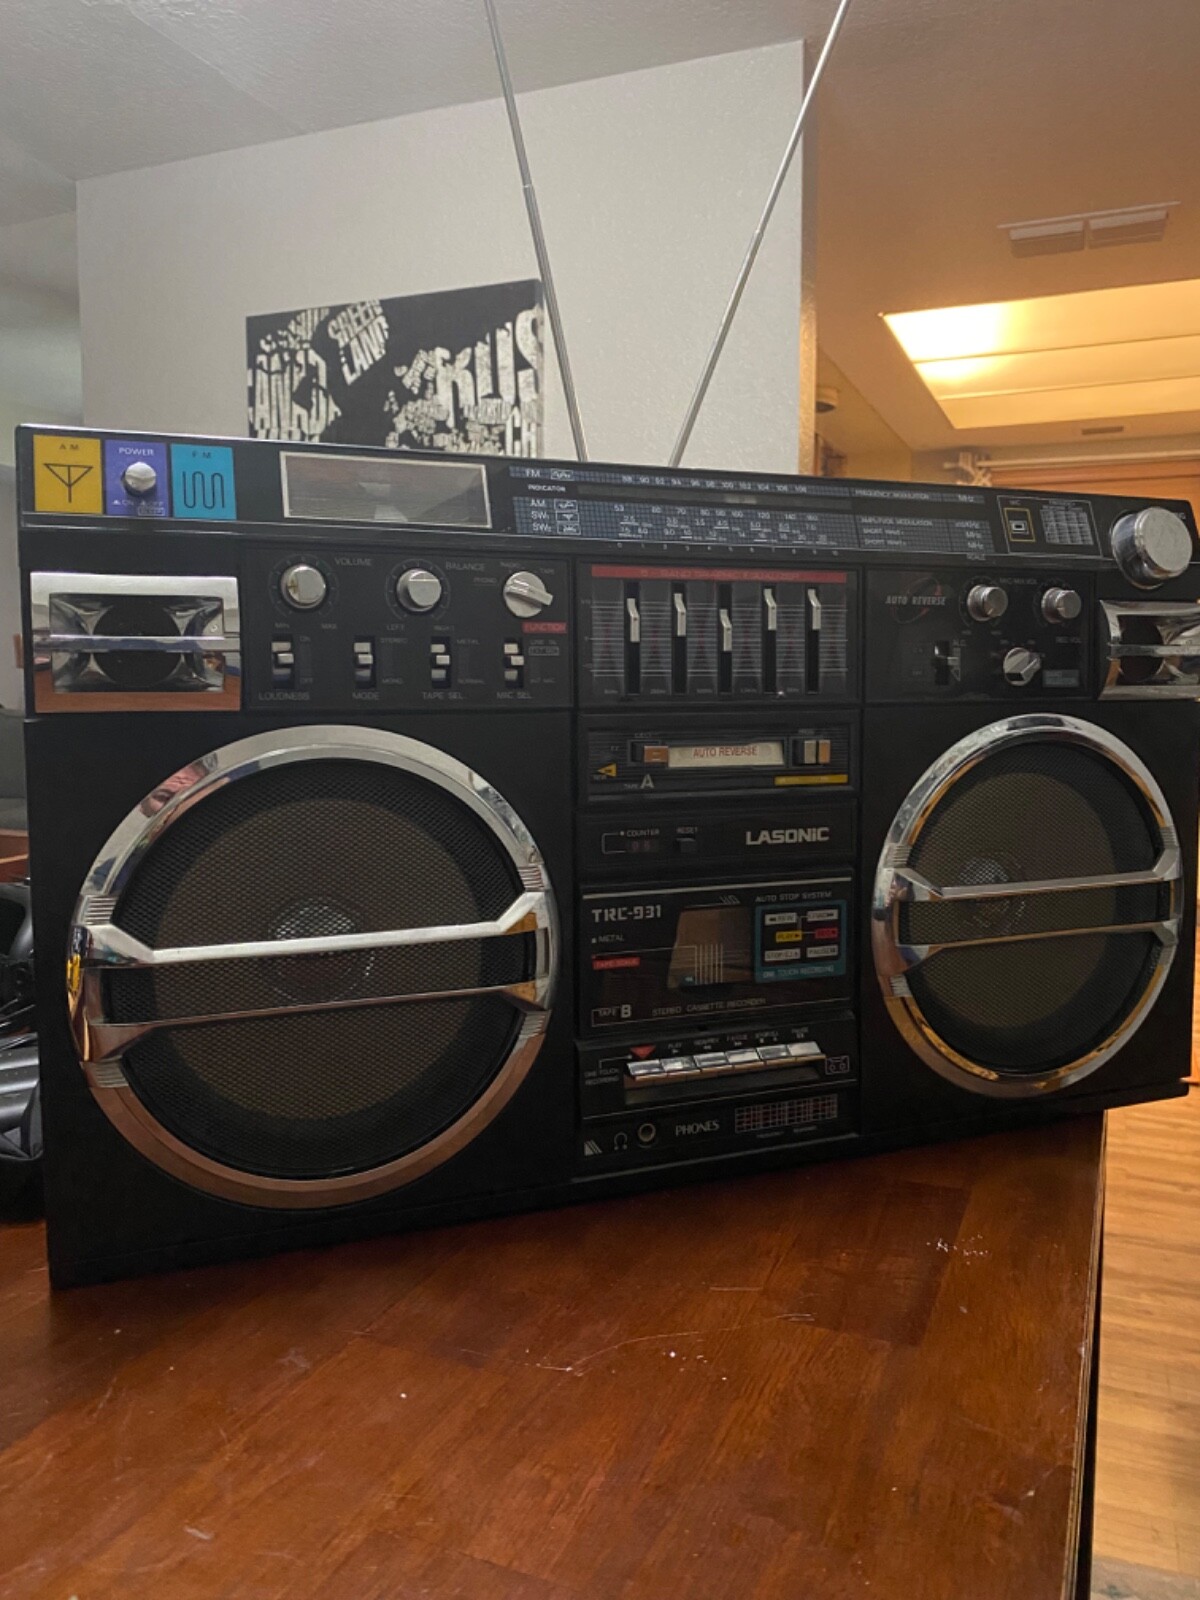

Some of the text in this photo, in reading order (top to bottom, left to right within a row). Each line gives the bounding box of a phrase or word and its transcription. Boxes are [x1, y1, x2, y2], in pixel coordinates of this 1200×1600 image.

[118, 447, 155, 456] POWER
[527, 484, 567, 493] INDICATOR
[334, 556, 372, 566] VOLUME
[445, 561, 486, 572] BALANCE
[885, 595, 947, 607] AUTO REVERSE
[258, 692, 310, 701] LOUDNESS
[352, 691, 380, 700] MODE
[423, 691, 444, 700] TAPE
[693, 745, 758, 758] AUTO REVERSE
[640, 774, 655, 790] A
[626, 828, 660, 837] COUNTER
[755, 891, 833, 903] AUTO STOP SYSTEM
[591, 905, 663, 923] TRC-931
[598, 935, 625, 943] METAL
[621, 1004, 632, 1018] B
[652, 998, 766, 1016] STEREO CASSETTE RECORDER
[675, 1120, 720, 1137] PHONES
